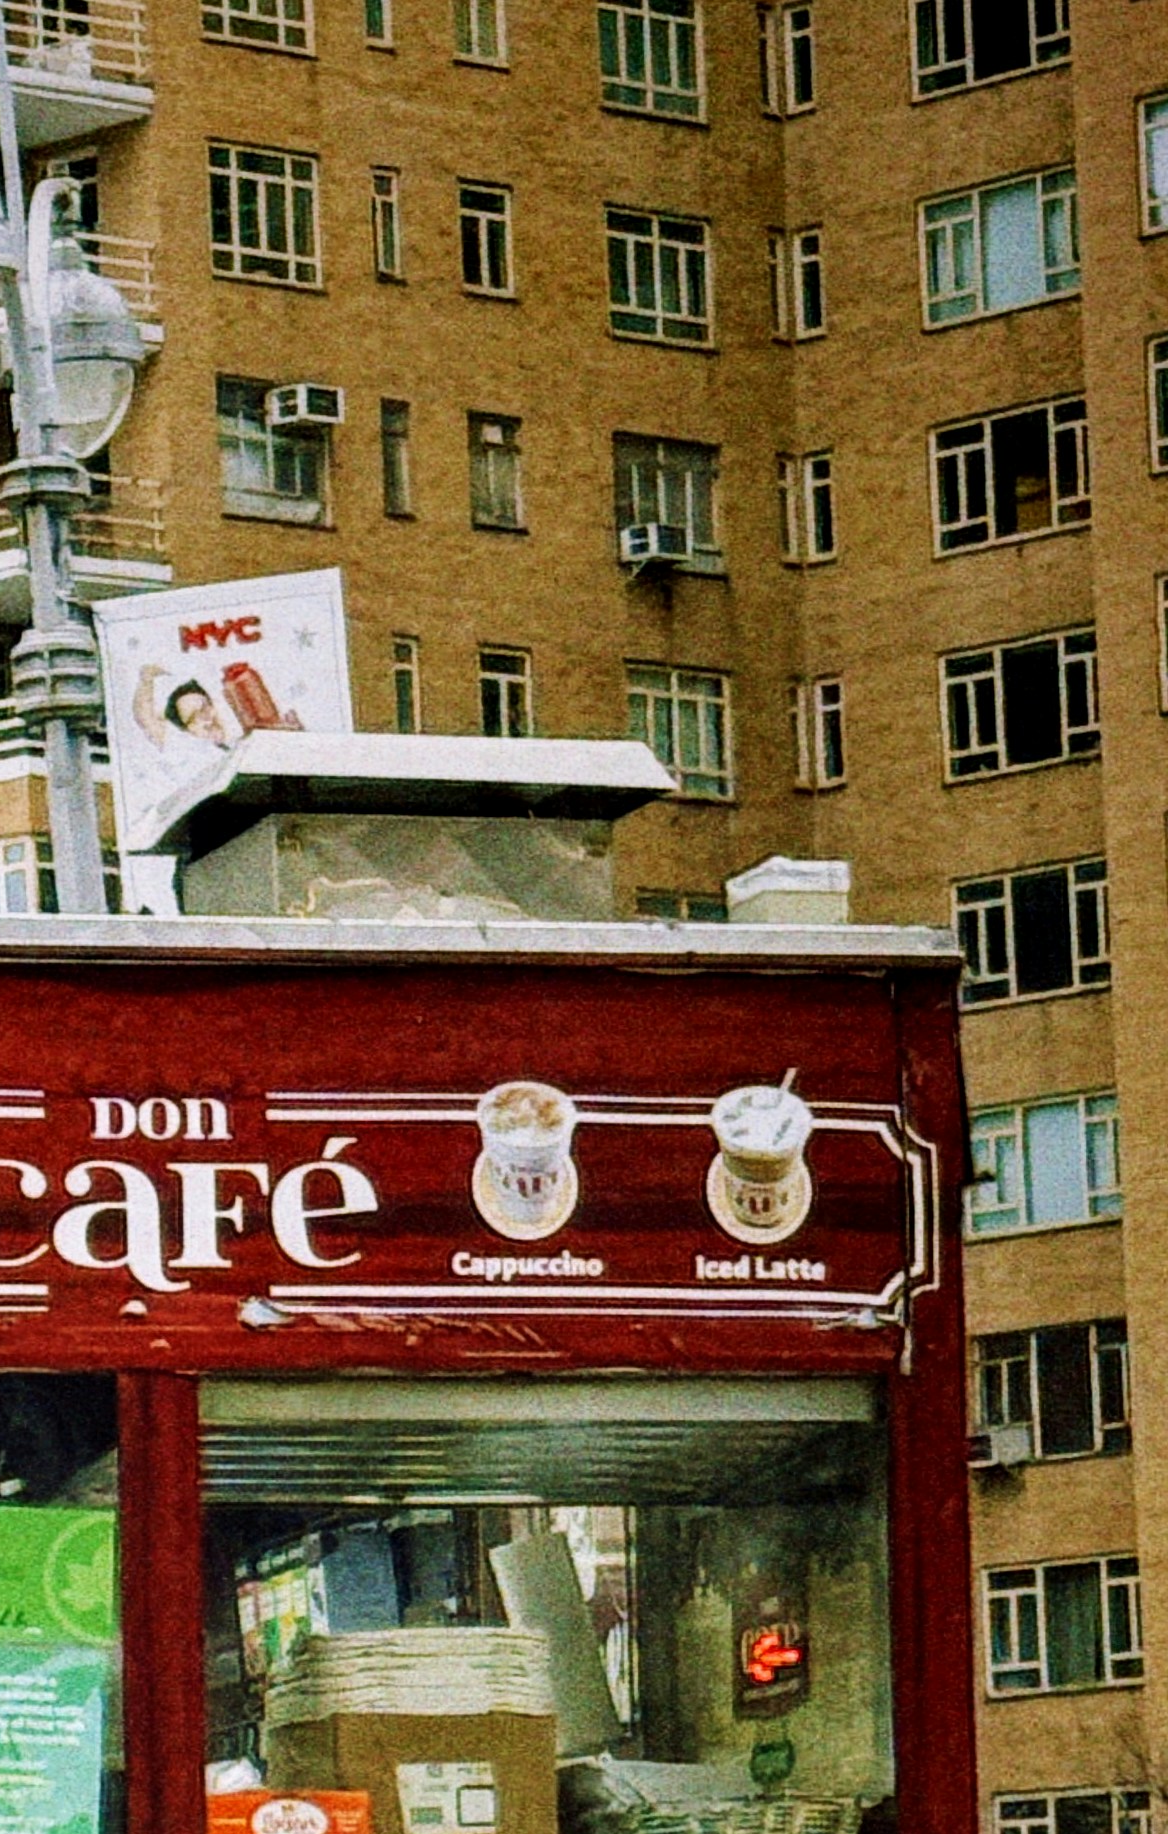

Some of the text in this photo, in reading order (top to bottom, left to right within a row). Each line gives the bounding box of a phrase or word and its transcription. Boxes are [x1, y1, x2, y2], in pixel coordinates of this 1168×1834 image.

[178, 615, 262, 653] NYC
[451, 1250, 605, 1281] Cappuccino
[695, 1254, 826, 1281] Iced Latte
